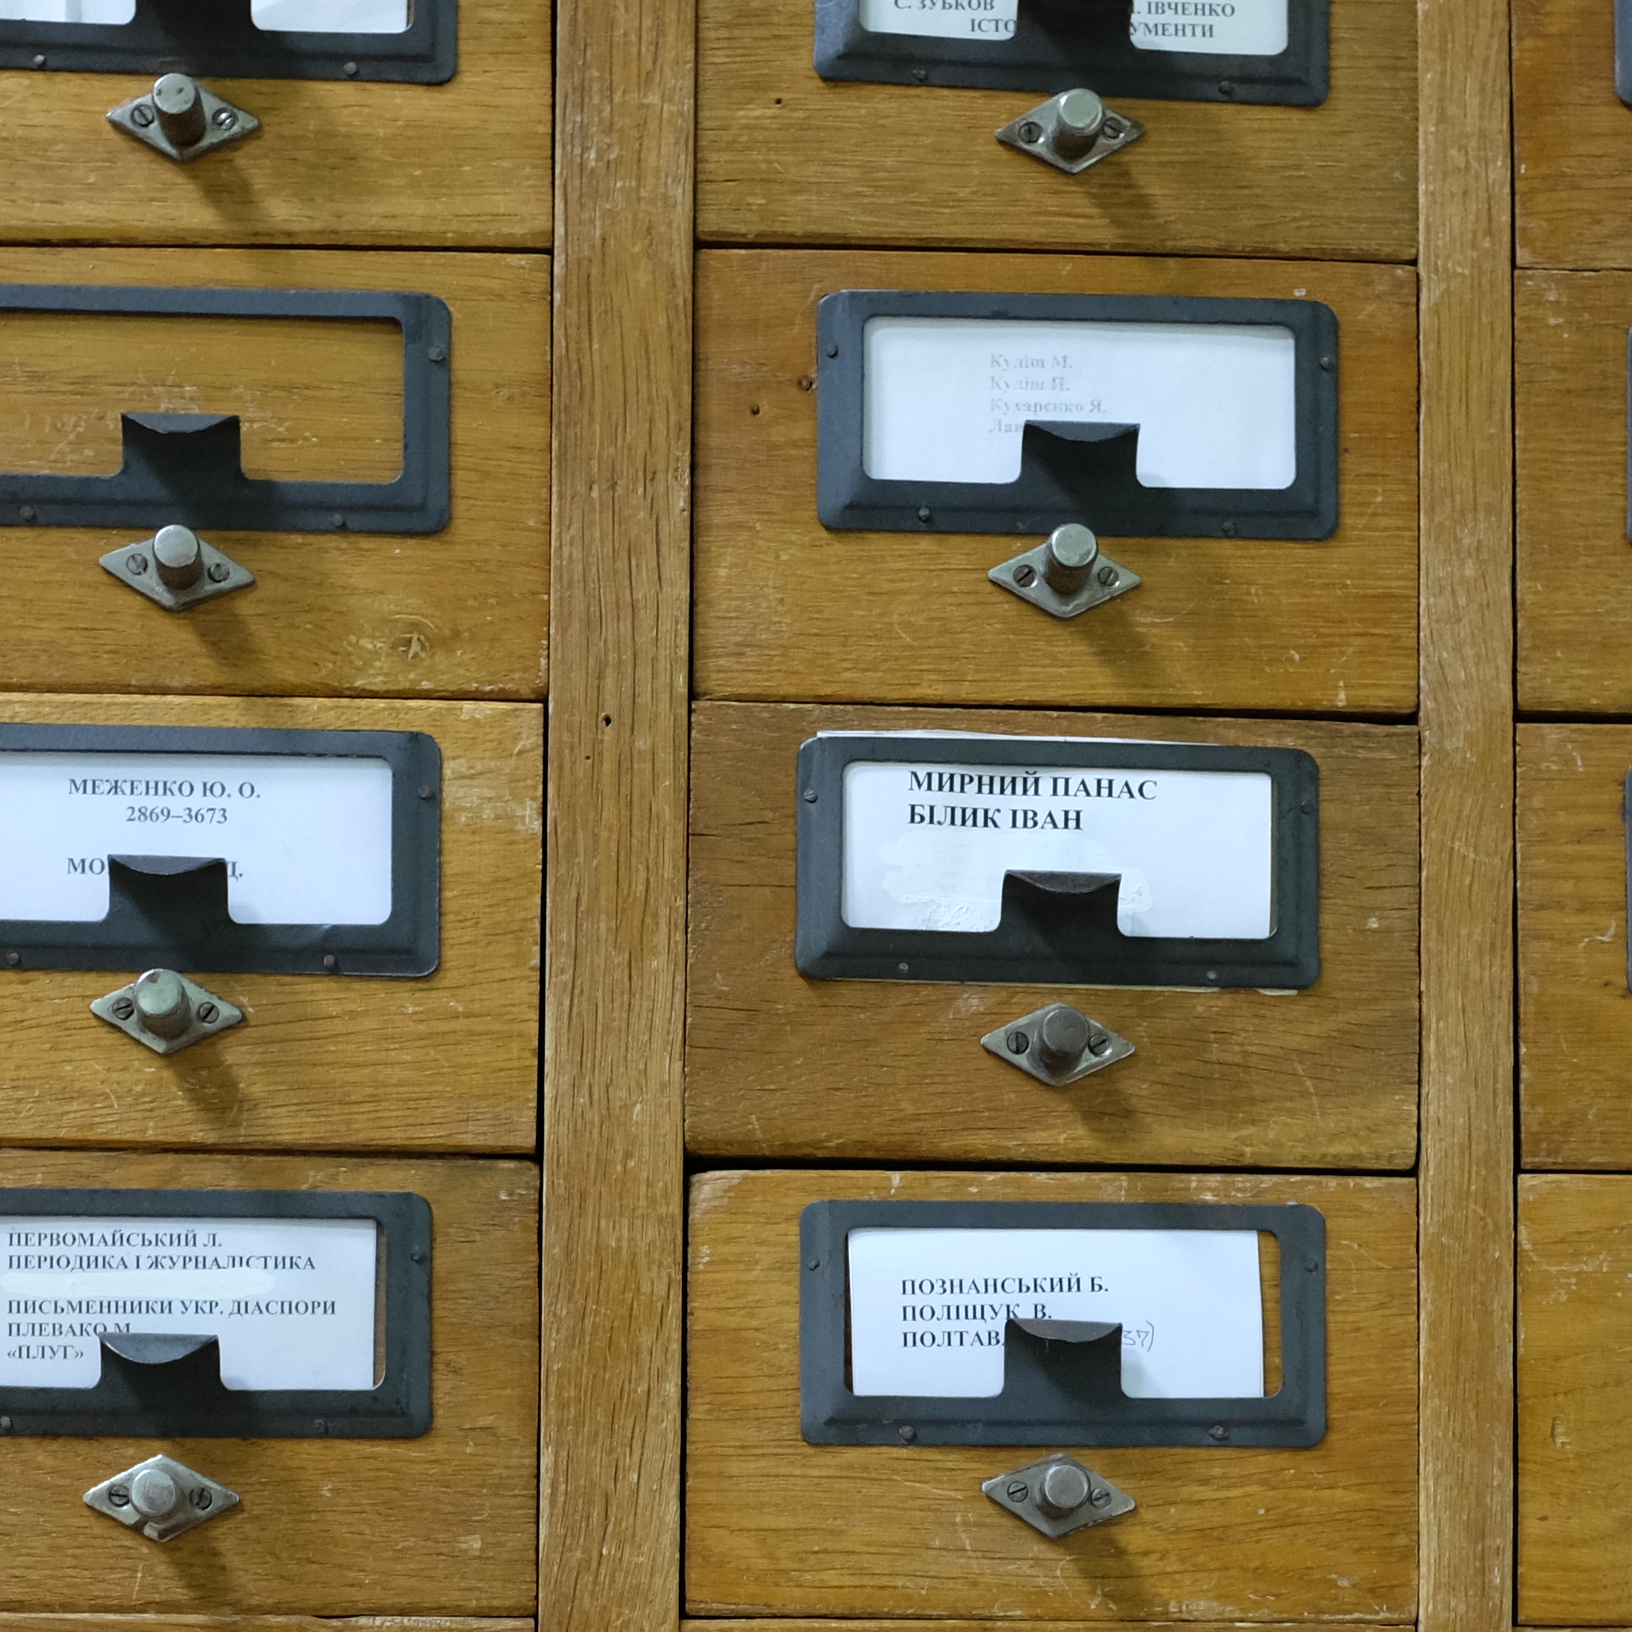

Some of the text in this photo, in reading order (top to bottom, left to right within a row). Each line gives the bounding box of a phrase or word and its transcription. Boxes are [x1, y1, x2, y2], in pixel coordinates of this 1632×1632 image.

[68, 778, 261, 799] МЕЖЕНКО Ю. О.
[909, 764, 1157, 800] МИРНИЙ ПАНАС
[125, 805, 228, 825] 2869–3673
[908, 803, 1083, 831] БІЛИК ІВАН
[8, 1228, 223, 1248] ПЕРВОМАЙСЬКИЙ Л.
[8, 1254, 129, 1273] ПЕРІОДИКА
[135, 1255, 142, 1270] І
[901, 1272, 1109, 1296] ПОЗНАНСЬКИЙ Б.
[8, 1299, 336, 1317] ПИСЬМЕННИКИ УКР. ДІАСПОРИ
[1033, 1303, 1052, 1320] В.
[7, 1345, 84, 1360] «ПЛУГ»
